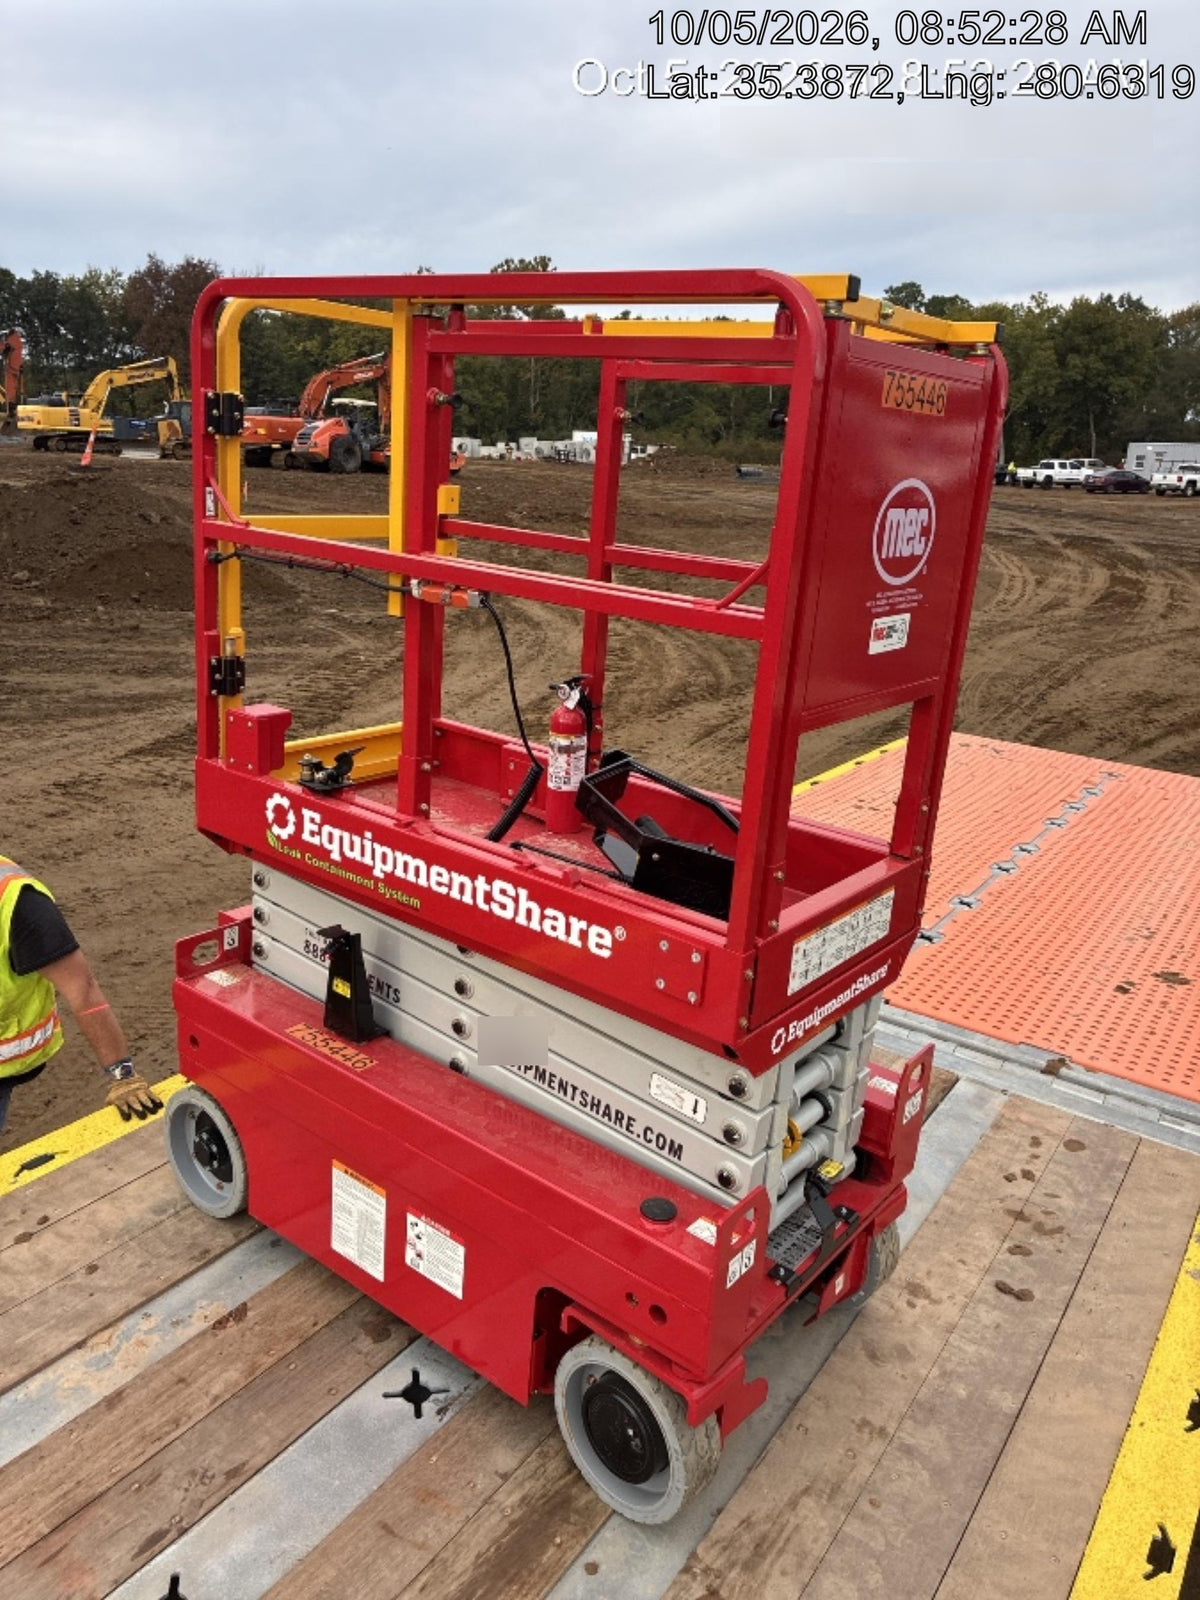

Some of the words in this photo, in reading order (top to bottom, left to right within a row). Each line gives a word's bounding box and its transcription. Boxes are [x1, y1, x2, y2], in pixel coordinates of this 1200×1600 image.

[885, 371, 947, 414] 755446
[305, 852, 374, 890] Containment
[378, 882, 421, 909] System
[367, 974, 401, 1003] ENTS
[289, 1023, 374, 1070] 755446
